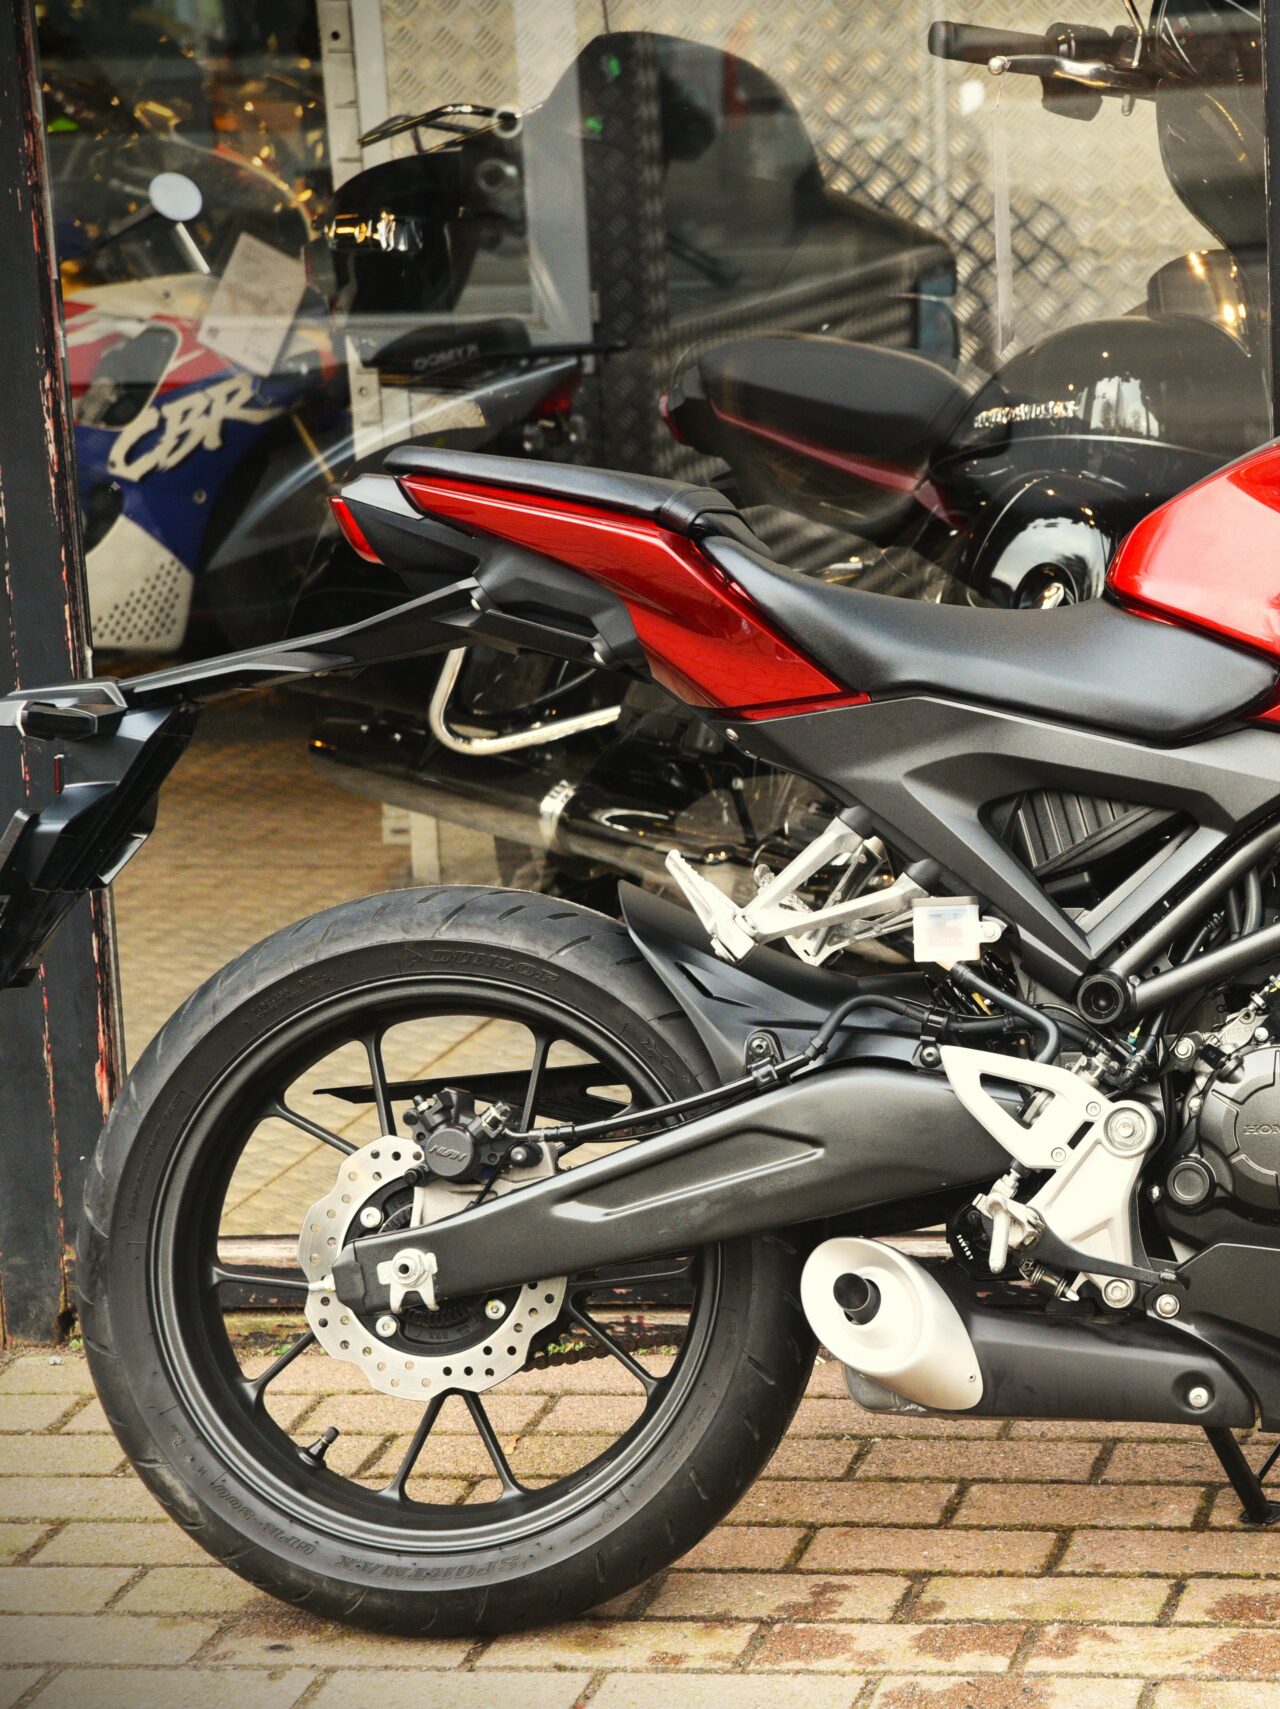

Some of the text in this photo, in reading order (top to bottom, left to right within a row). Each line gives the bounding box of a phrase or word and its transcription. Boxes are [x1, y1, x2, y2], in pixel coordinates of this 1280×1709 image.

[107, 374, 286, 483] CBR
[430, 949, 560, 984] DUNLOP
[333, 1552, 522, 1581] SPORTMAX
